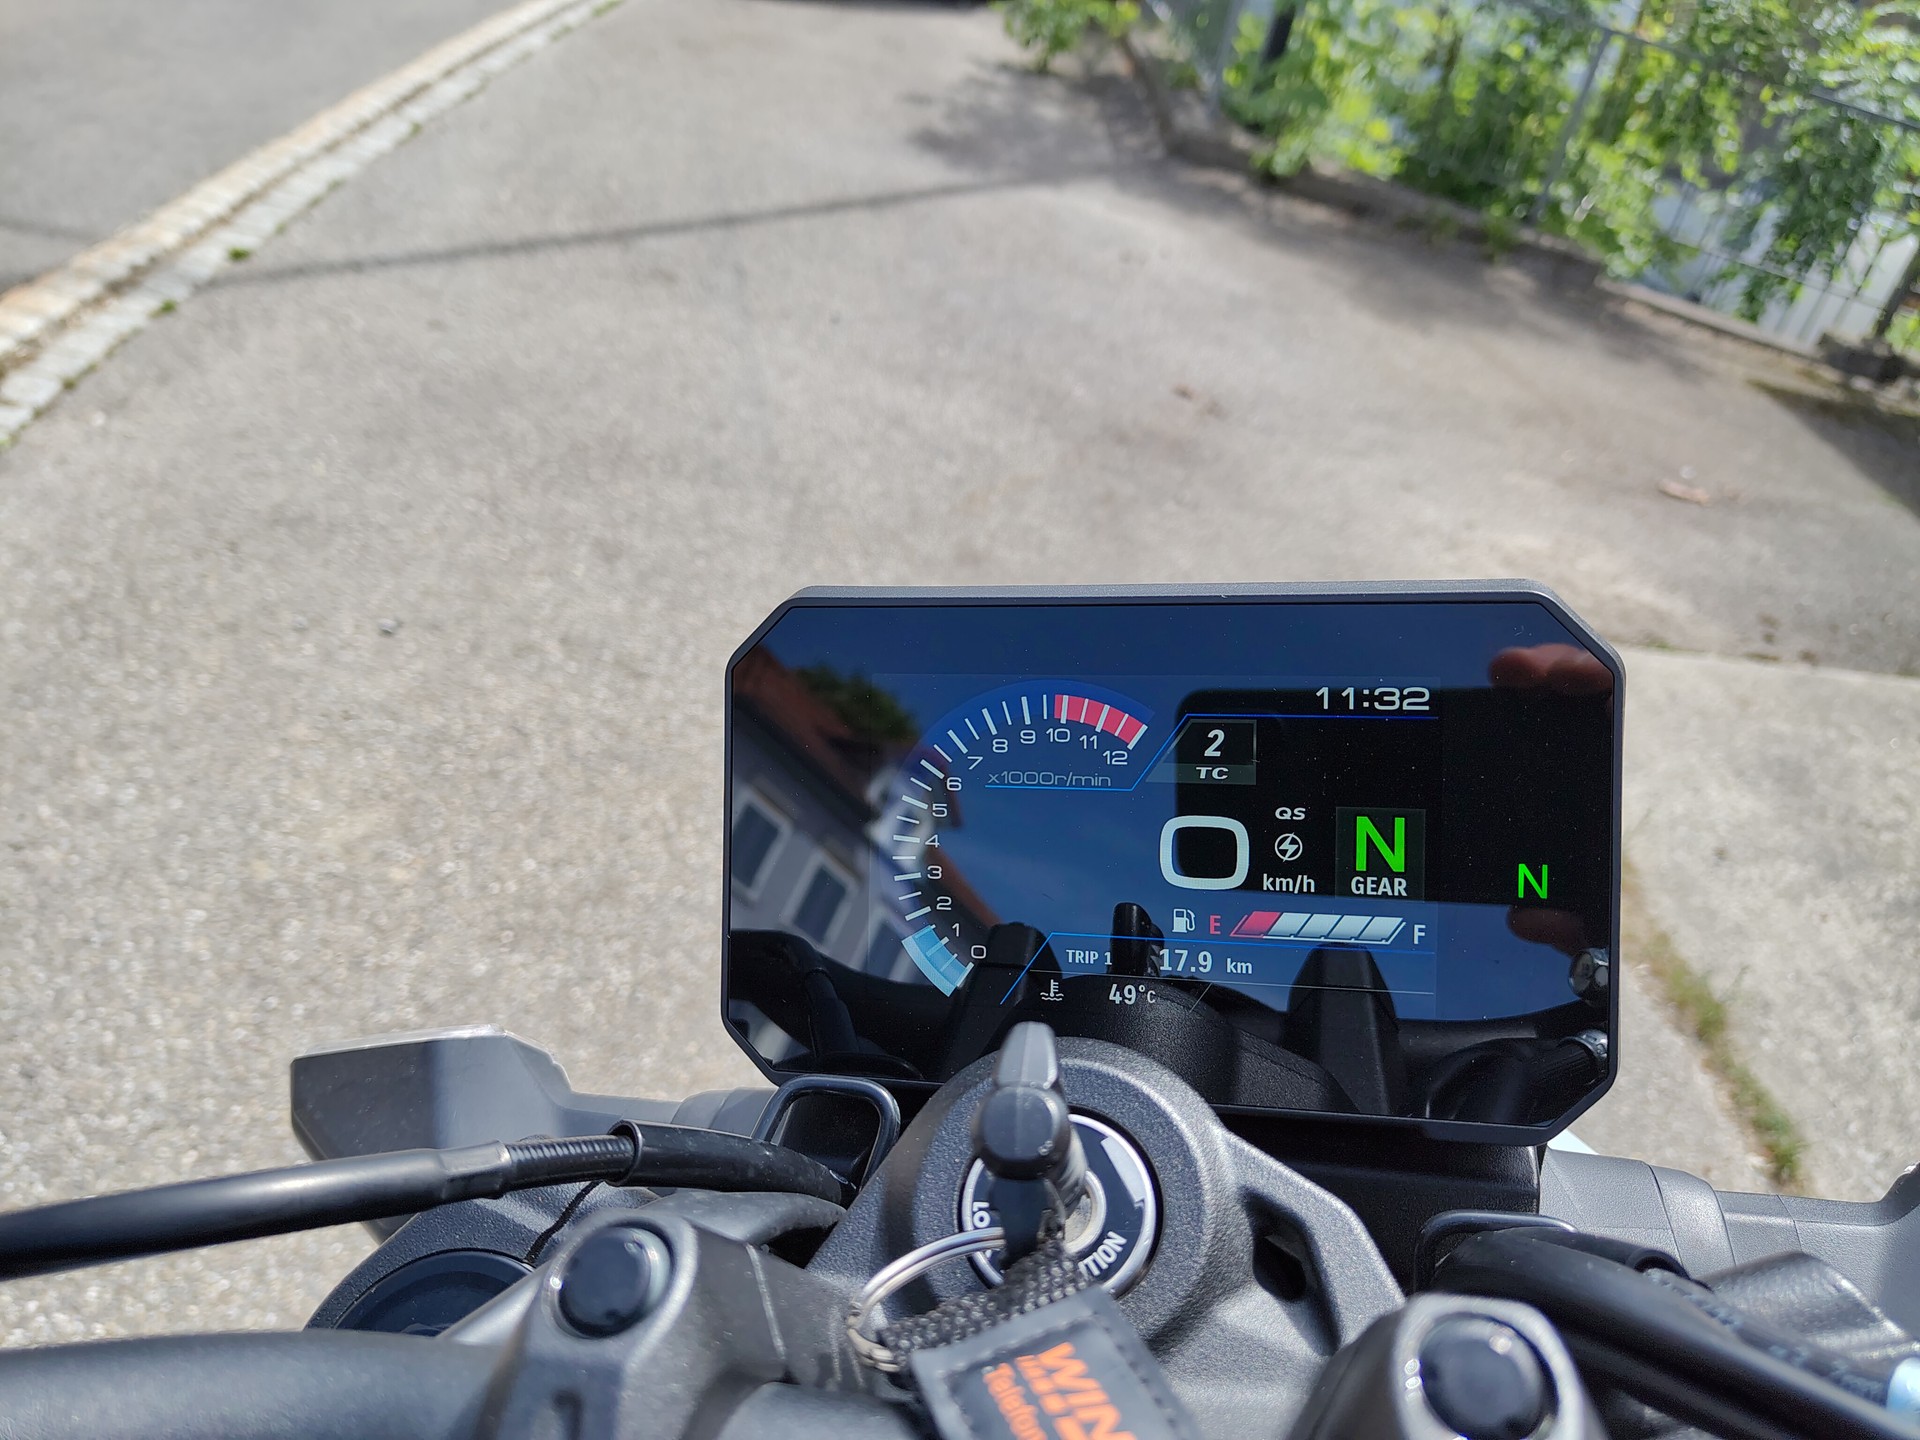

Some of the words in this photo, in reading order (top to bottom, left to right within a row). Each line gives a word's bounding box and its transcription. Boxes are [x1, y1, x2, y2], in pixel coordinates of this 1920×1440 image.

[1315, 686, 1430, 711] 11:32
[1020, 730, 1036, 744] 9
[1046, 727, 1071, 743] 10
[1079, 735, 1098, 750] 11
[992, 739, 1008, 753] 8
[1204, 729, 1225, 757] 2
[967, 756, 983, 770] 7
[1103, 751, 1128, 765] 12
[988, 771, 1111, 787] x1000r/min
[1196, 767, 1229, 780] TC
[946, 777, 962, 791] 6
[932, 803, 948, 817] 5
[1275, 807, 1306, 821] QS
[925, 835, 940, 848] 4
[1355, 816, 1405, 872] N
[1159, 815, 1250, 890] 0
[927, 865, 942, 880] 3
[1262, 873, 1315, 893] km/h
[1351, 876, 1408, 897] GEAR
[1517, 863, 1548, 899] N
[936, 896, 952, 911] 2
[952, 923, 960, 937] 1
[1209, 915, 1222, 935] E
[1413, 924, 1426, 944] F
[970, 945, 987, 959] 0
[1065, 949, 1099, 964] TRIP
[1104, 951, 1113, 965] 1
[1159, 949, 1212, 973] 17.9
[1226, 957, 1253, 974] km
